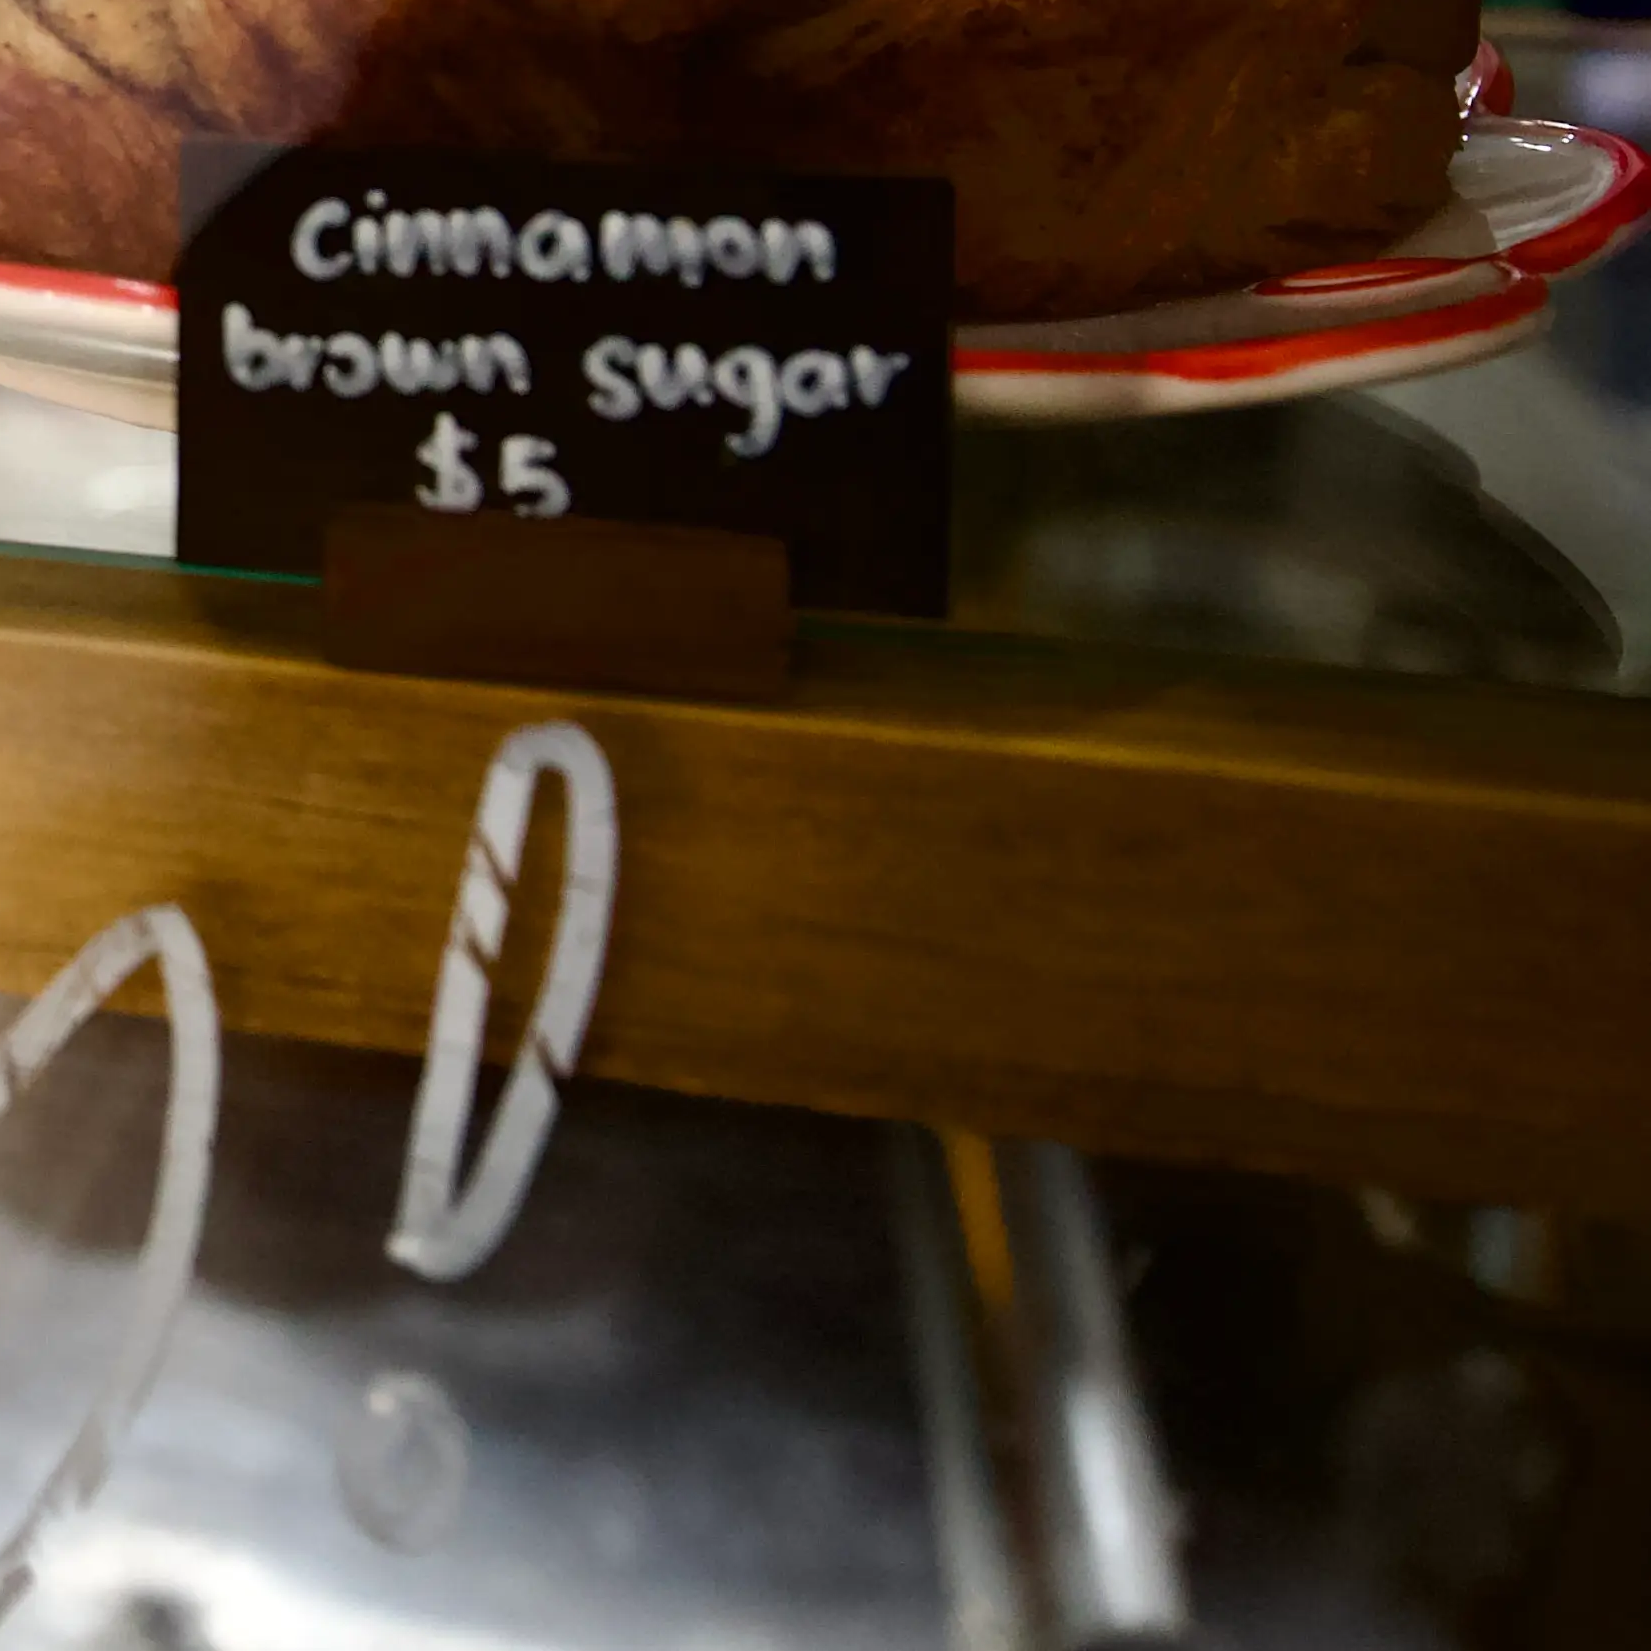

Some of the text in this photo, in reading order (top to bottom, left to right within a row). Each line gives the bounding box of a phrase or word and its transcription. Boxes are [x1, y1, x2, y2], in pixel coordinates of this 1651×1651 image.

[222, 301, 911, 457] brown sugar
[414, 411, 571, 519] $5
